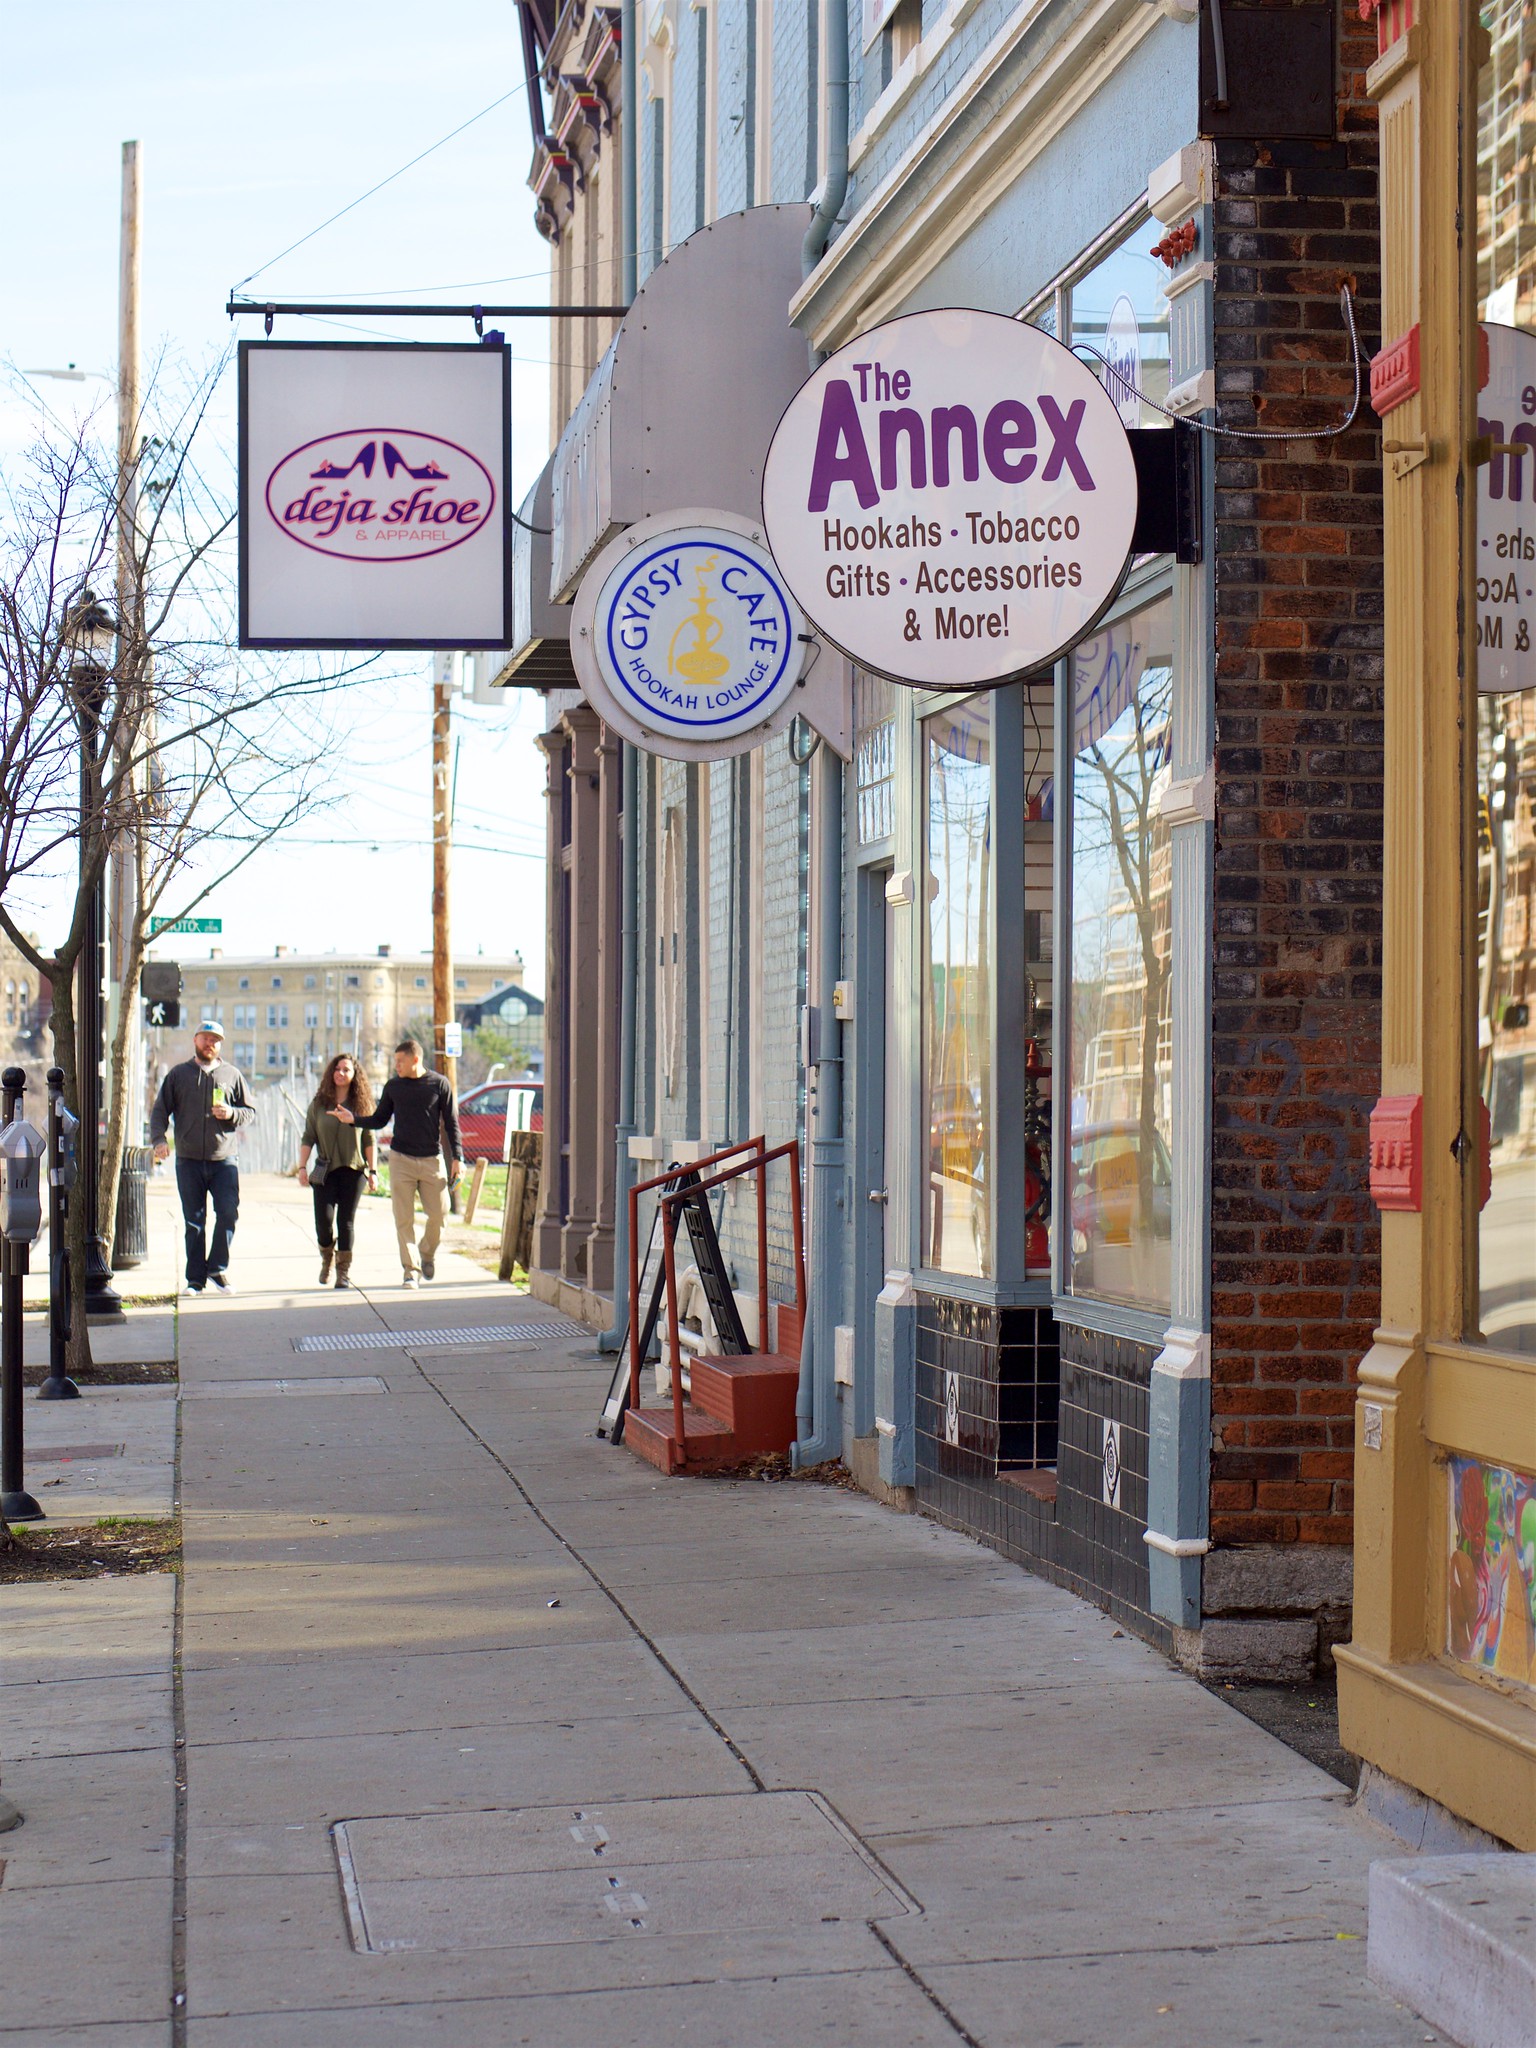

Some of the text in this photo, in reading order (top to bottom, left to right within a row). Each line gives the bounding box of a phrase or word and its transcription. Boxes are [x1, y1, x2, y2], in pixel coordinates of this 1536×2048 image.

[853, 362, 911, 402] The
[808, 380, 1097, 513] Annex
[283, 486, 482, 540] deja shoe
[823, 511, 1080, 551] Hookahs Tobacco
[355, 530, 452, 541] & APPAREL
[826, 556, 1082, 598] Gifts Accessories
[620, 558, 778, 654] GYPSY CAFE
[903, 604, 1010, 642] & More!
[628, 657, 769, 710] HOOKAH LOUNGE
